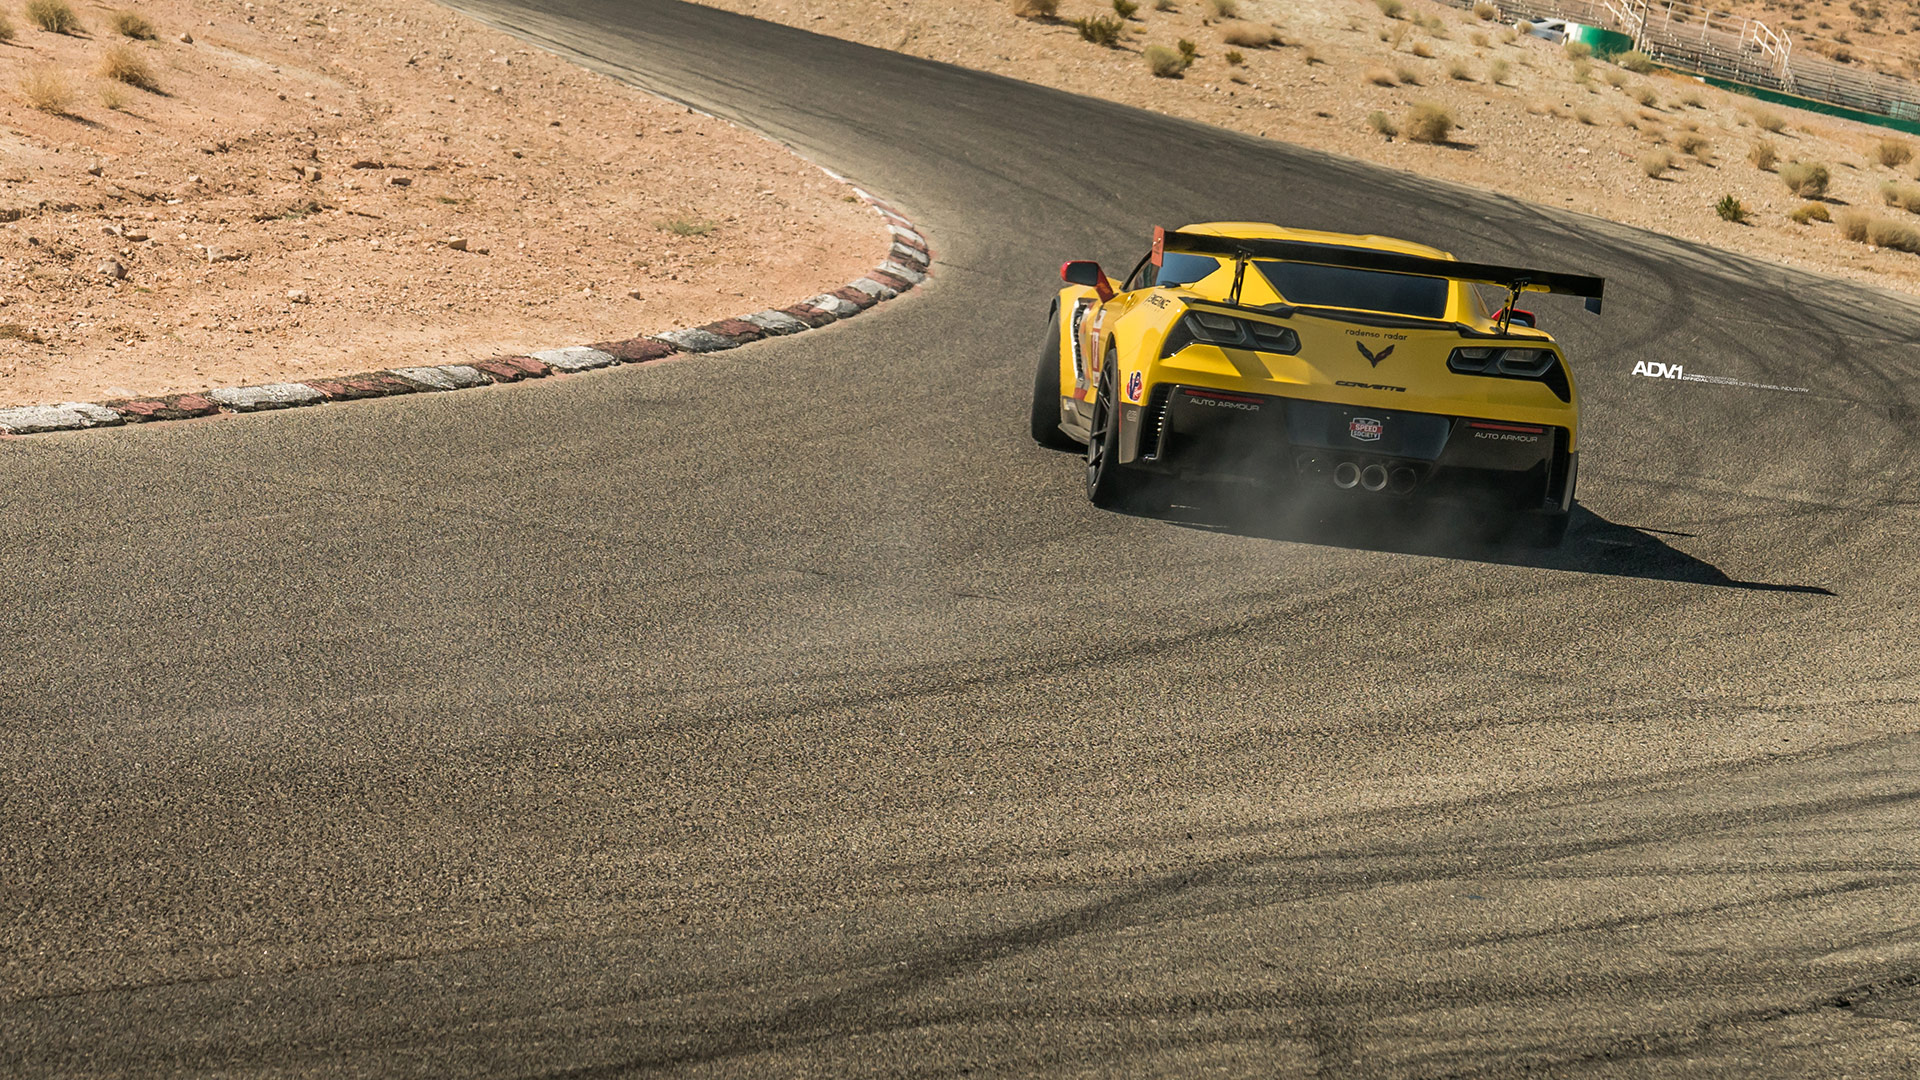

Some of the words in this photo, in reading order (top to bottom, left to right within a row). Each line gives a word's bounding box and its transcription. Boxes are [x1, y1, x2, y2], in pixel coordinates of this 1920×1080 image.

[1345, 329, 1380, 338] radenso
[1384, 333, 1408, 341] radar
[1335, 380, 1407, 392] CORVETTE
[1190, 397, 1216, 407] AUTO
[1217, 401, 1260, 412] ARMOUR
[1355, 423, 1378, 433] SPEED
[1353, 430, 1378, 438] SOCIETY
[1474, 431, 1499, 439] AUTO
[1500, 434, 1537, 442] ARMOUR
